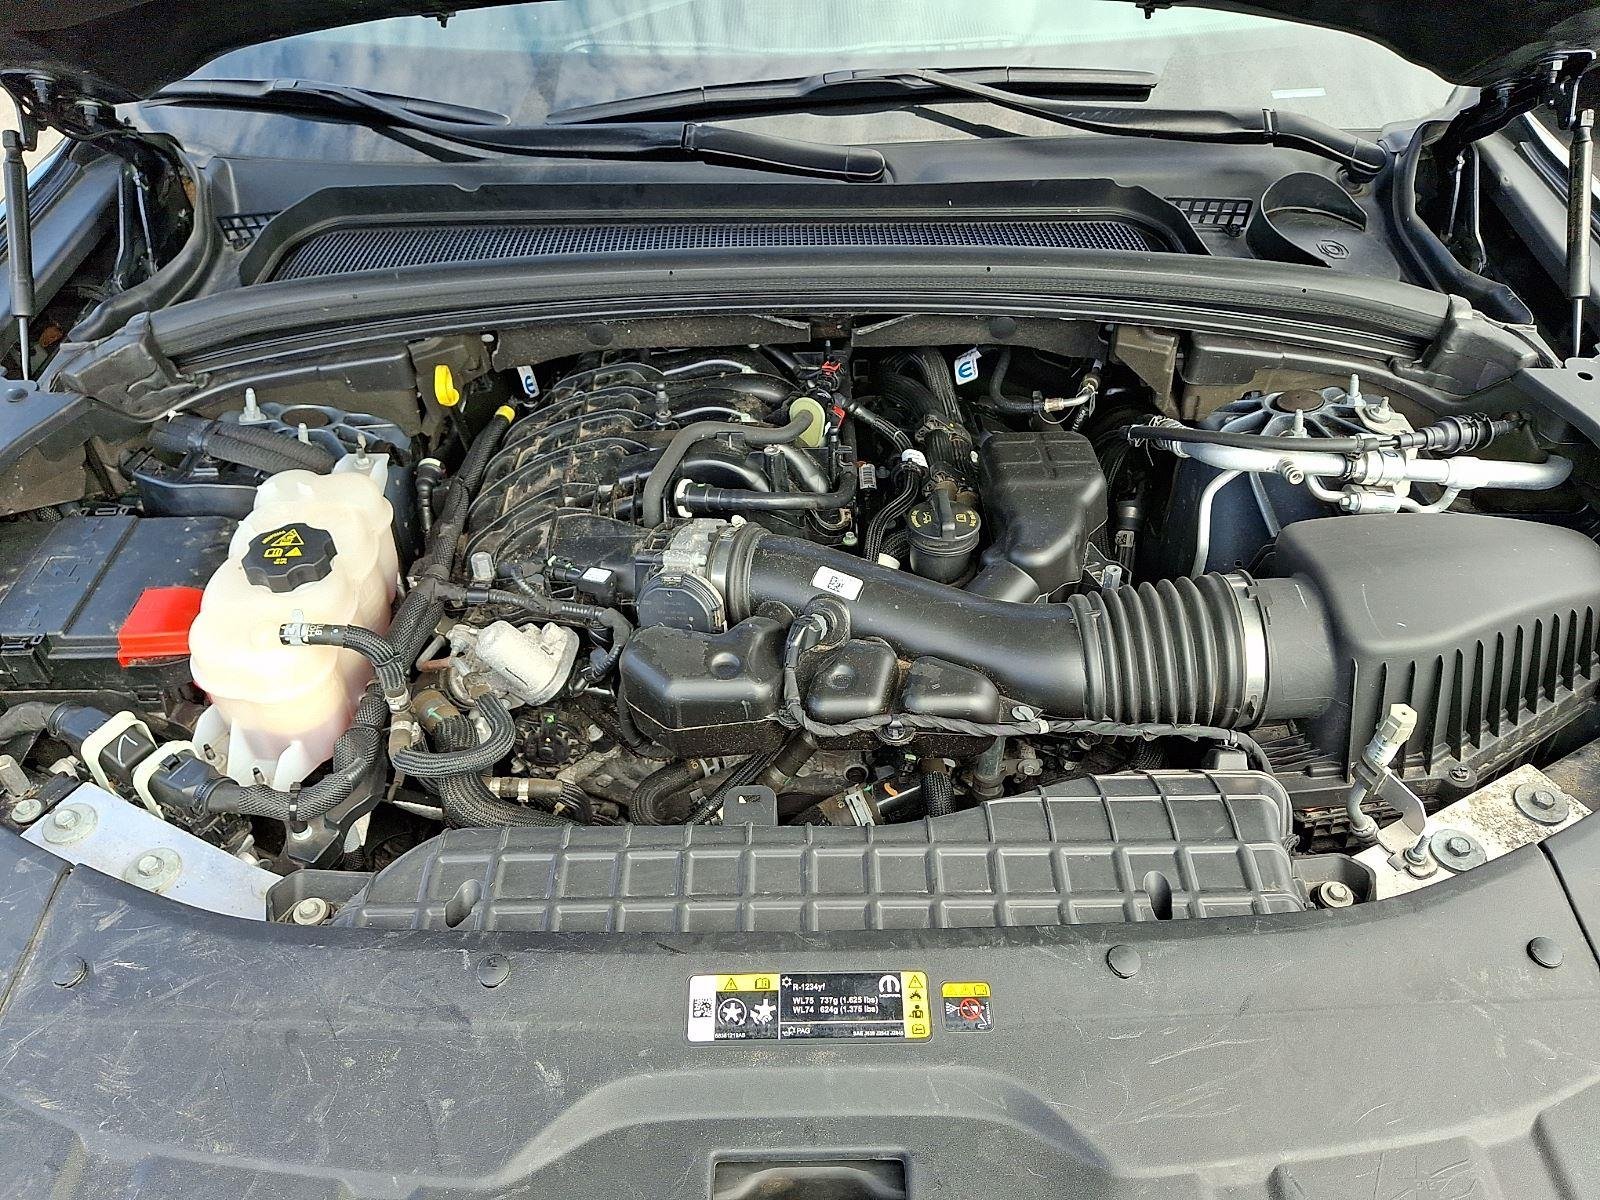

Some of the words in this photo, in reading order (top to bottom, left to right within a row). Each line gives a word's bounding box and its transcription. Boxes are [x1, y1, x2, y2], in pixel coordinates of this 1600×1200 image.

[792, 982, 826, 992] R-1234yf
[792, 996, 815, 1005] WL75
[819, 996, 839, 1006] 737g
[840, 996, 863, 1005] (1.625
[863, 995, 879, 1005] lbs)
[792, 1005, 815, 1014] WL74
[819, 1005, 839, 1015] 624g
[840, 1005, 863, 1014] (1.375
[863, 1004, 879, 1014] lbs)
[796, 1027, 811, 1035] PAG
